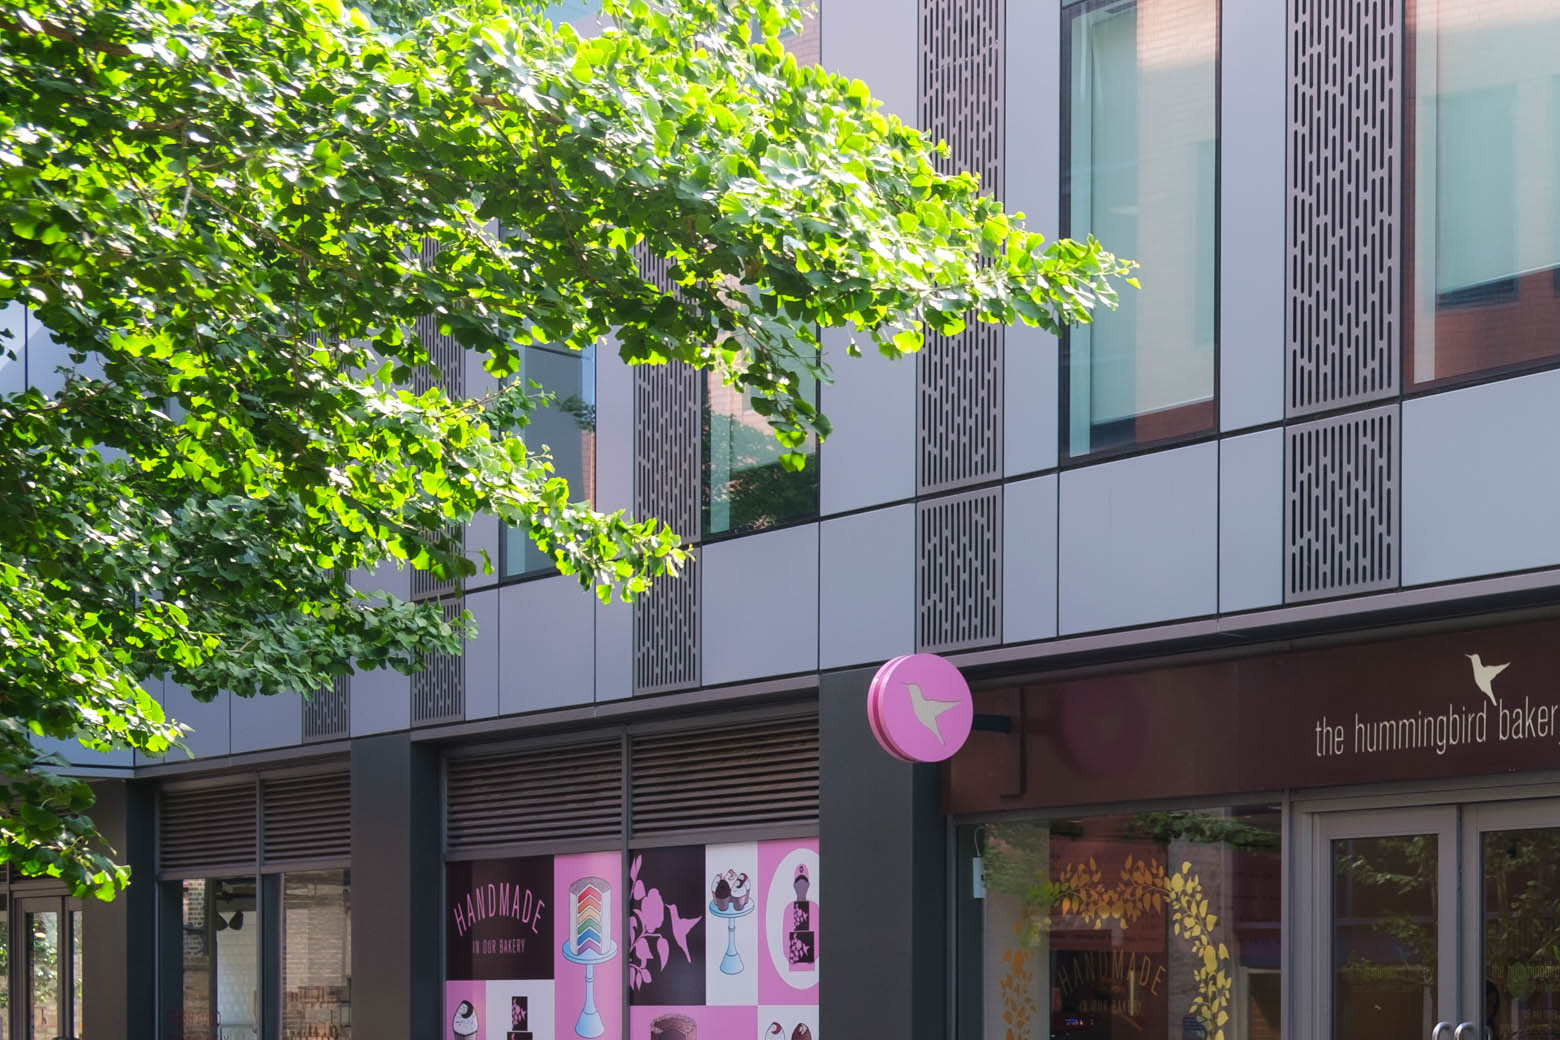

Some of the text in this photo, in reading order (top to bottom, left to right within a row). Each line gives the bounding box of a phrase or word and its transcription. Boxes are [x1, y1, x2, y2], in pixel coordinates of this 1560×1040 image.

[1315, 716, 1344, 757] the
[1354, 699, 1487, 755] hummingbird
[453, 882, 545, 937] HANDMADE
[472, 937, 526, 955] IN OUR BAKERY
[1057, 948, 1167, 997] HANDMADE
